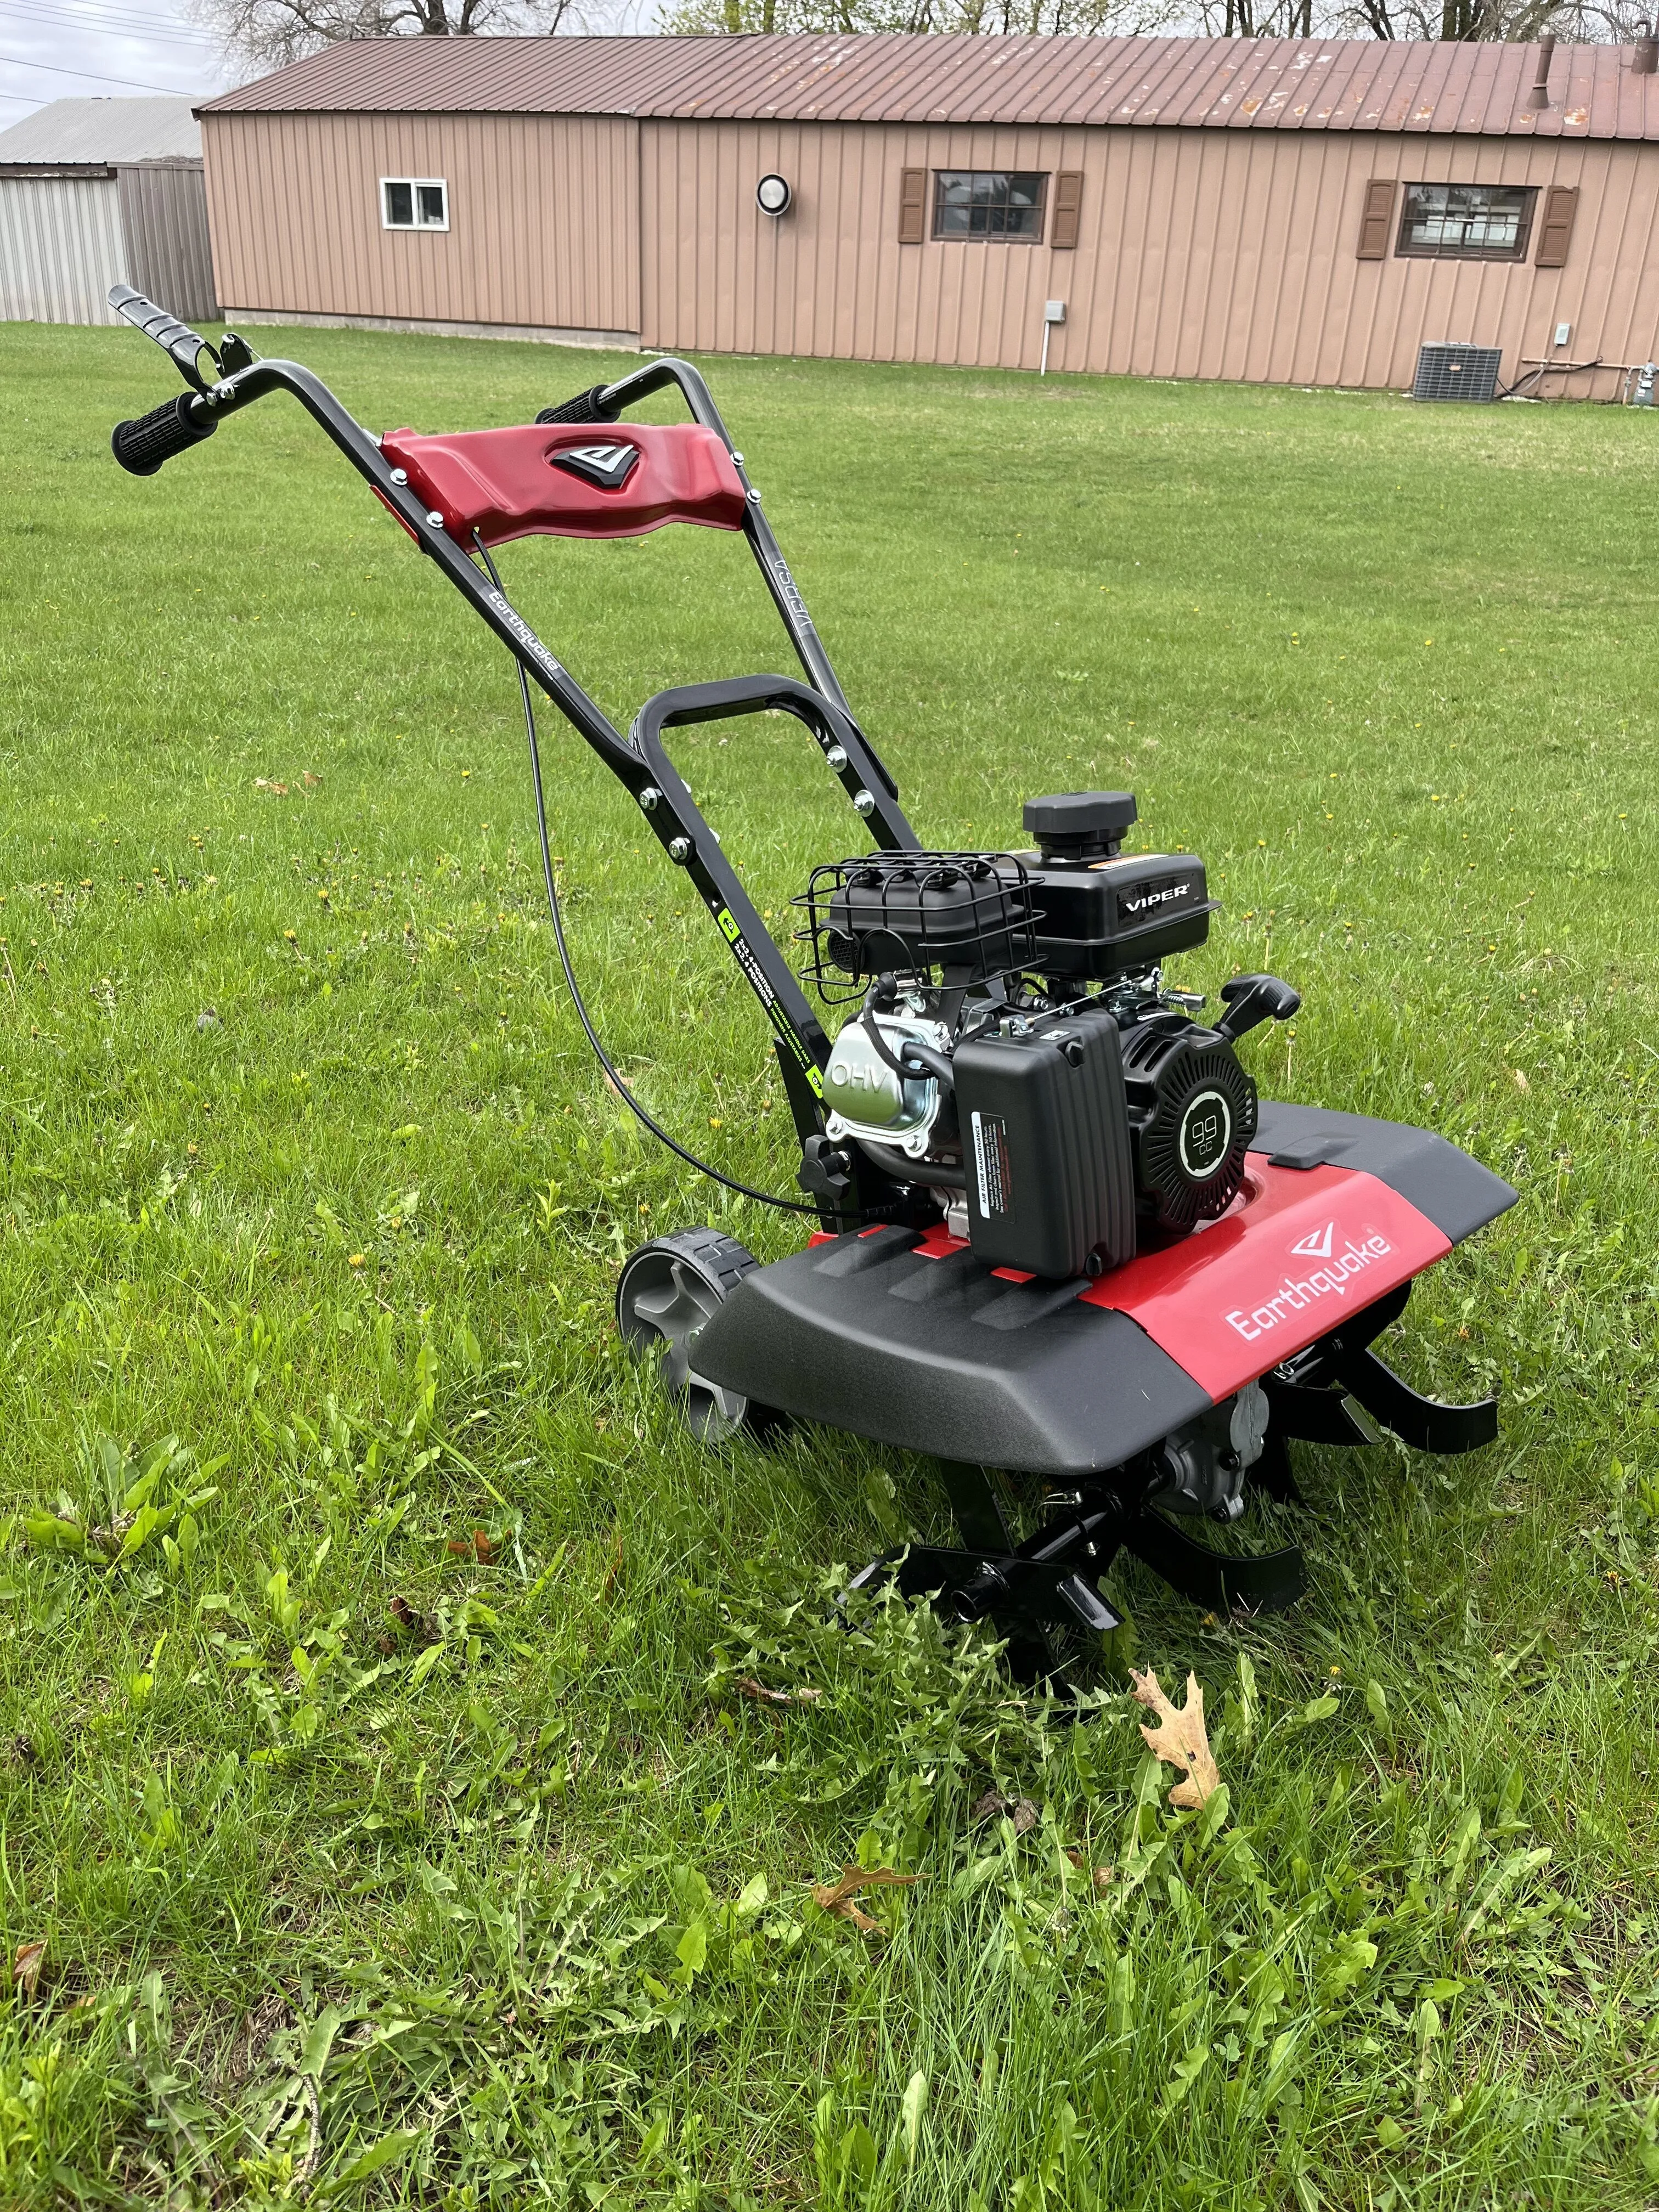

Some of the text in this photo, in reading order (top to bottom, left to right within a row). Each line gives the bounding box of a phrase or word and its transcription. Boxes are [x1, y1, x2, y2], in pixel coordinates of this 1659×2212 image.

[488, 591, 558, 671] Earthquake
[1126, 884, 1189, 911] VIPER
[748, 956, 775, 999] 4-POSITION
[772, 1000, 791, 1030] ADJUSTABLE
[789, 1029, 803, 1049] HANDLE
[748, 967, 772, 1007] POSITIONS
[785, 1033, 803, 1062] AJUSTABLES
[831, 1061, 888, 1094] OHV
[975, 1125, 984, 1172] MAINTENANCE
[1192, 1115, 1217, 1147] 99
[1224, 1235, 1392, 1341] Earthquake
